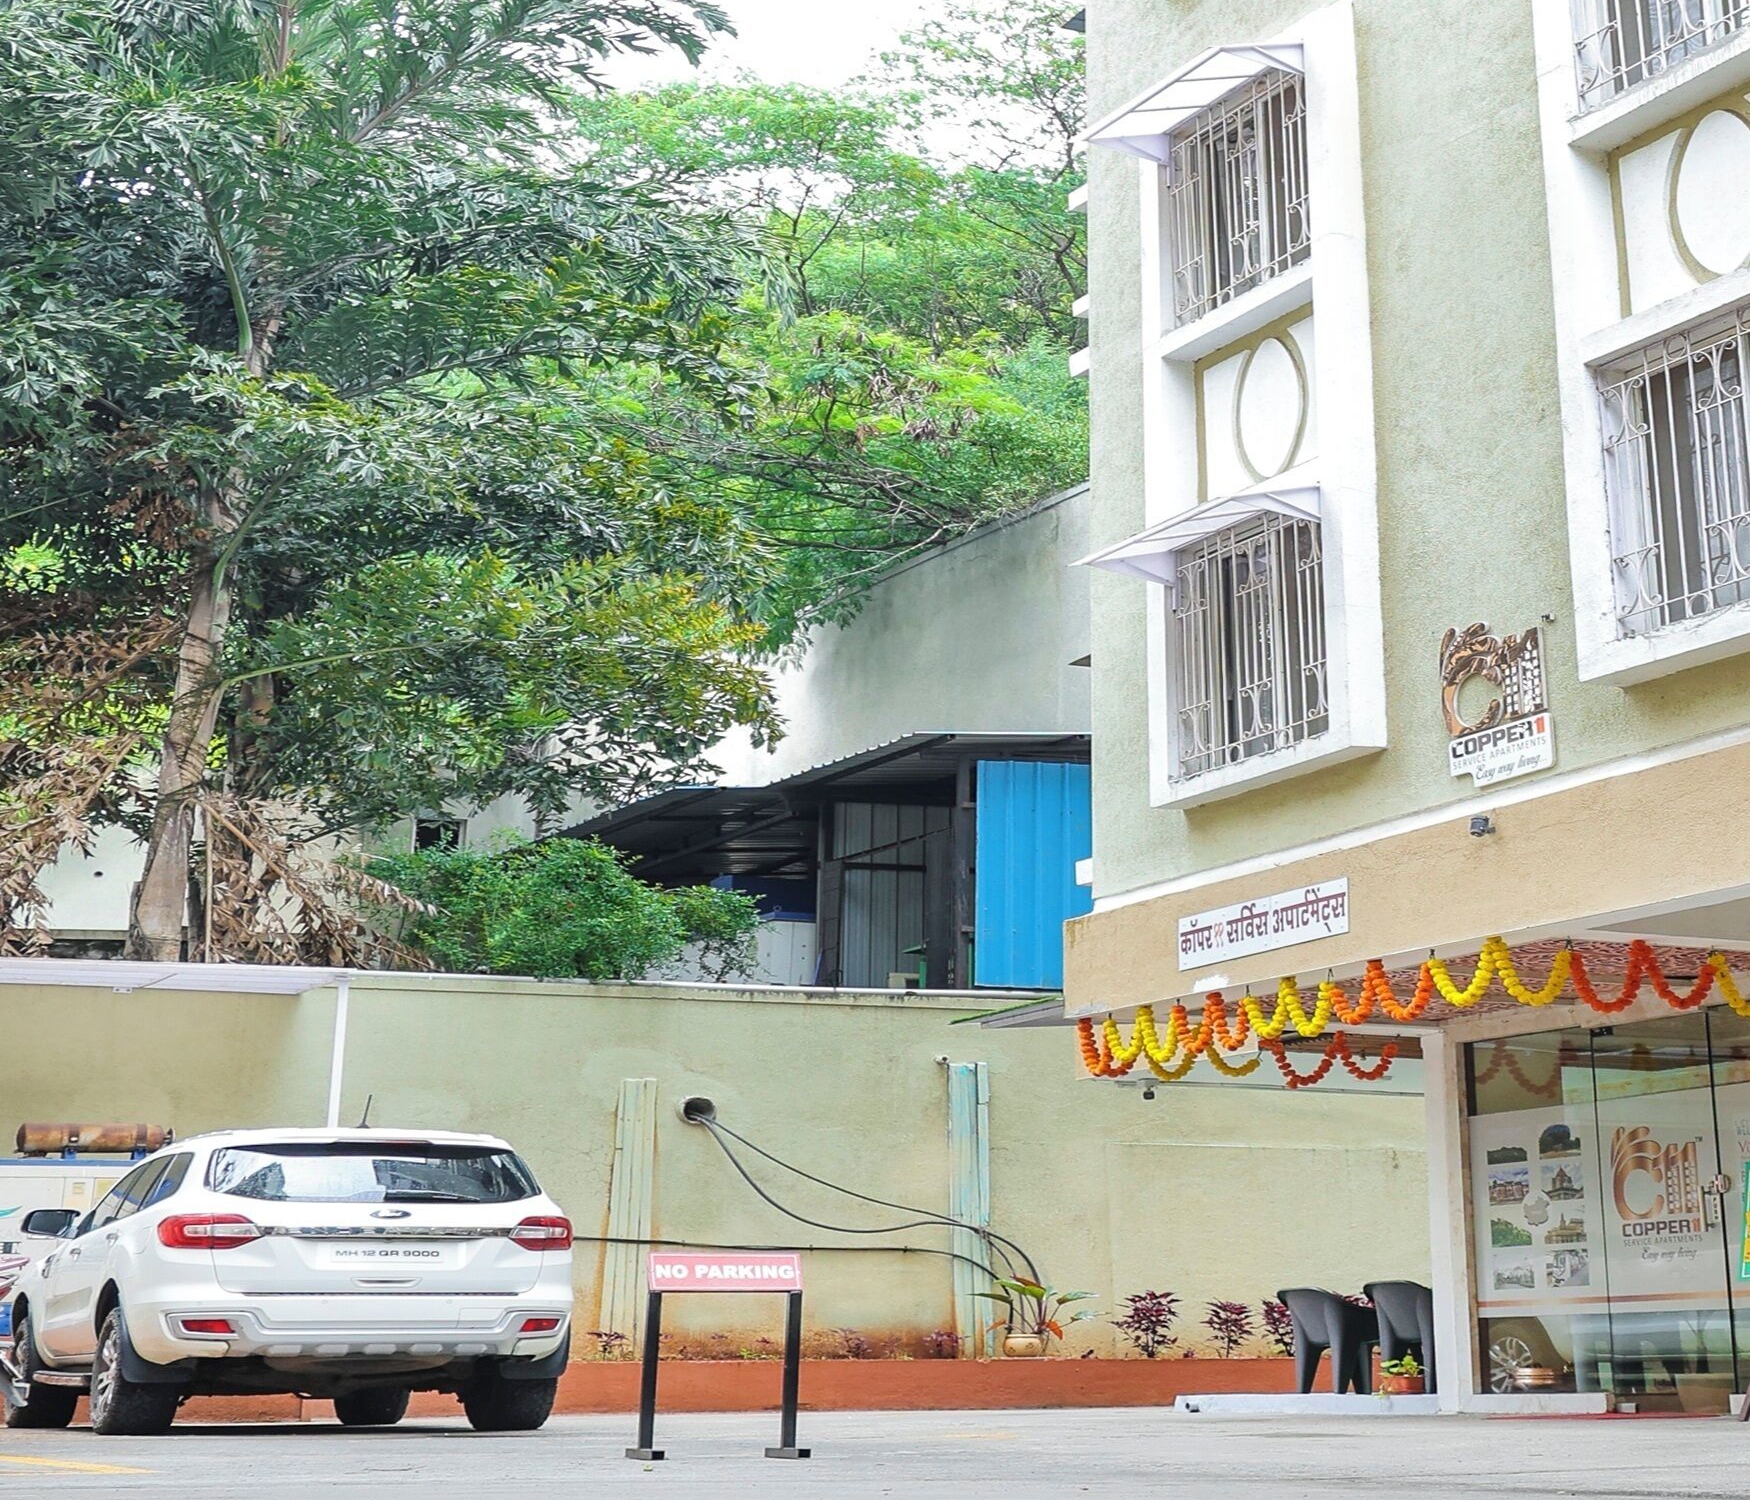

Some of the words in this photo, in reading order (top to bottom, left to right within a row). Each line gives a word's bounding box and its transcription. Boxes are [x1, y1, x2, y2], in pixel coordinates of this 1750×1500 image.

[1452, 753, 1487, 771] SERVICE
[1490, 736, 1547, 759] APARTMENTS
[1226, 903, 1269, 943] सर्विस
[1623, 1237, 1652, 1247] SERVICE
[1655, 1234, 1704, 1245] APARTMENTS
[378, 1249, 400, 1257] QR
[403, 1250, 440, 1258] 9000
[655, 1263, 689, 1279] NO
[694, 1264, 796, 1280] PARKING
